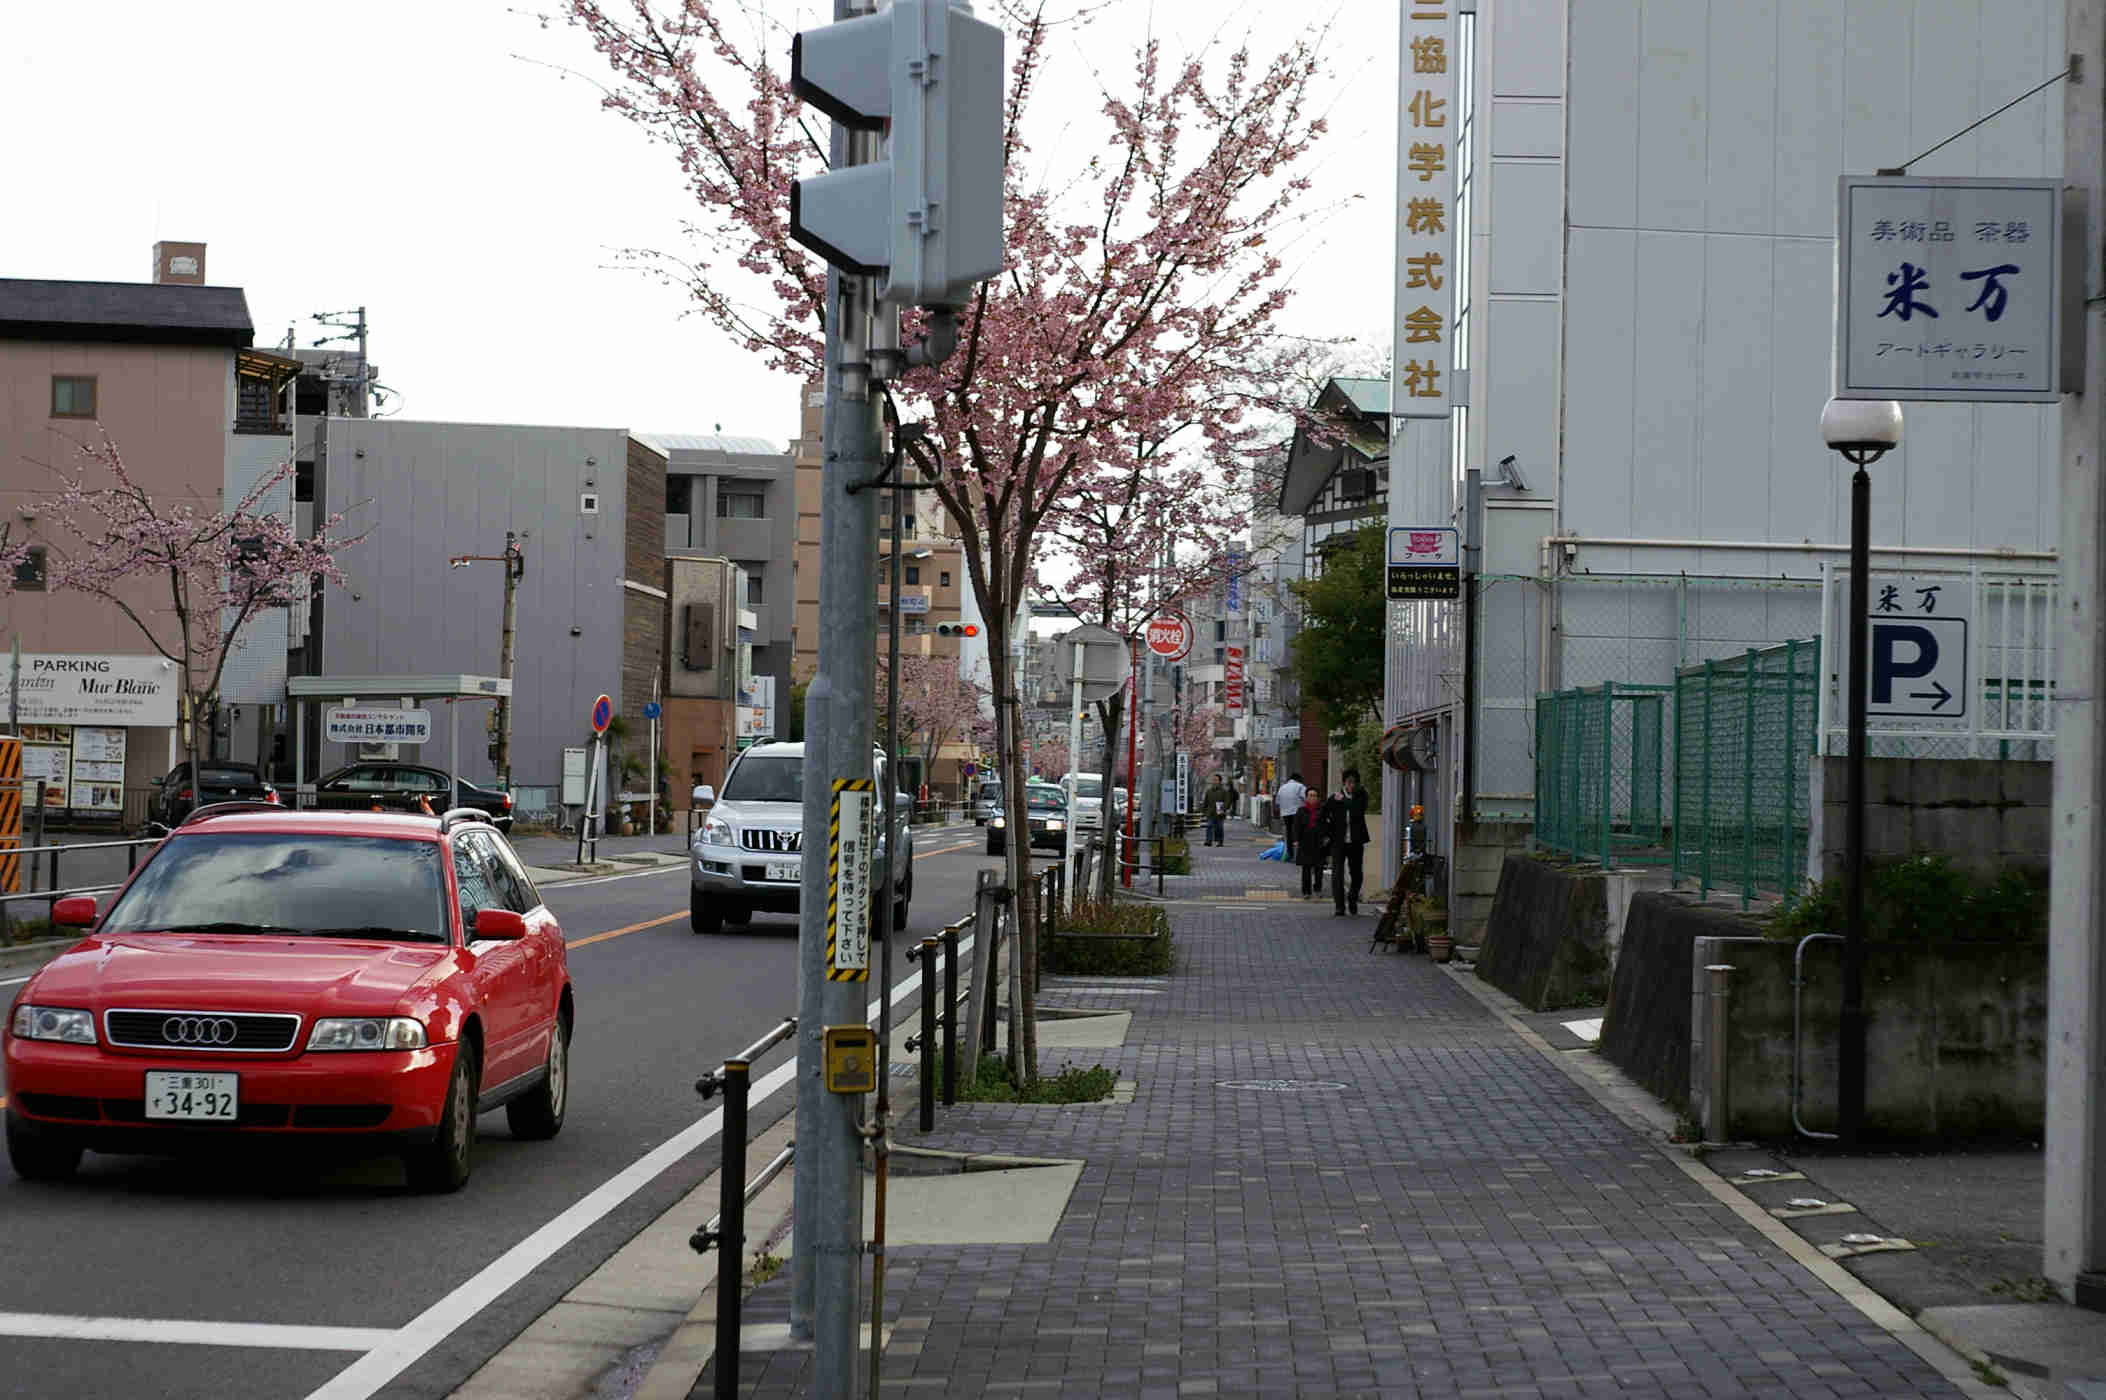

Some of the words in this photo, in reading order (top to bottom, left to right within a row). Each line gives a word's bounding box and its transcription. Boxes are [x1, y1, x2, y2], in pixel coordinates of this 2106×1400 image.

[1871, 219, 1955, 243] 美術品
[1974, 220, 2031, 243] 茶器
[1875, 342, 2028, 360] アートギャラリー
[1148, 628, 1184, 644] 消火栓
[33, 659, 111, 673] PARKING
[1871, 624, 1939, 704] P
[78, 677, 113, 695] Mur
[166, 1092, 233, 1116] 34-92
